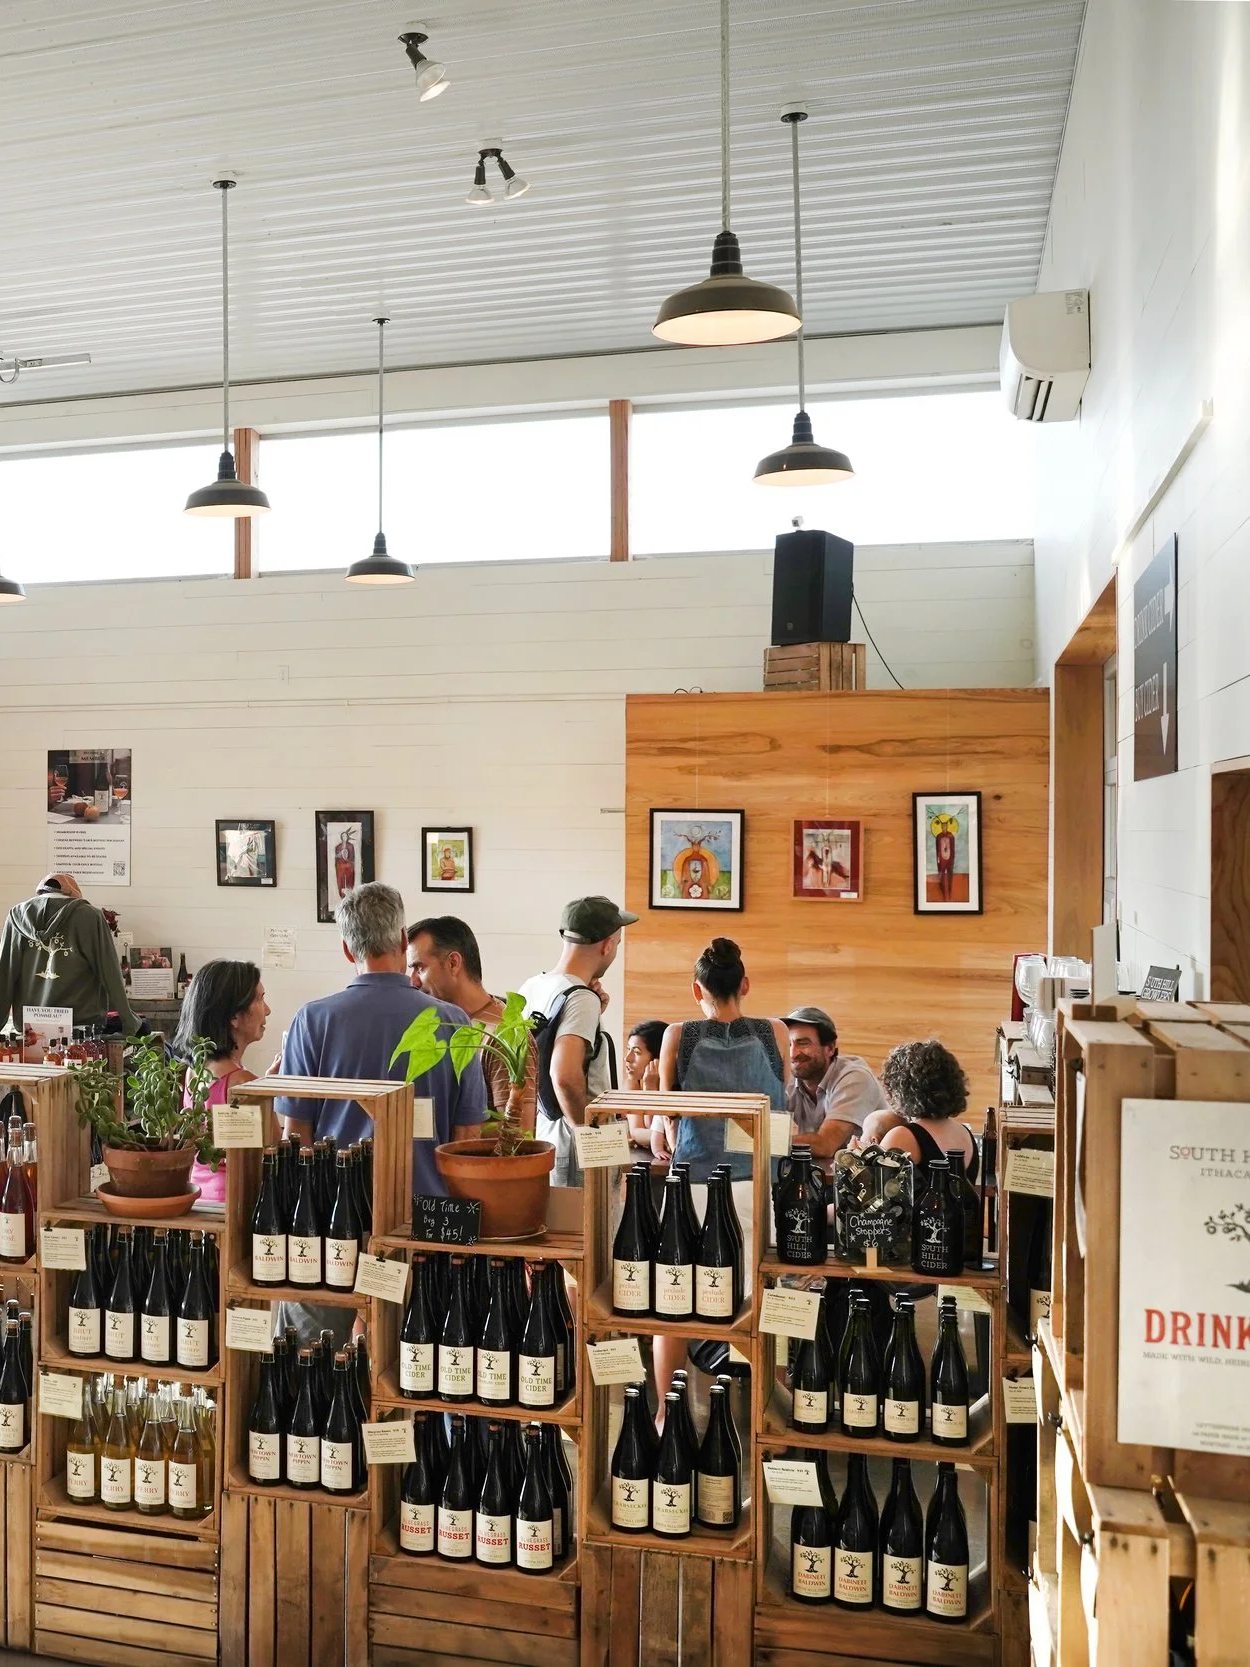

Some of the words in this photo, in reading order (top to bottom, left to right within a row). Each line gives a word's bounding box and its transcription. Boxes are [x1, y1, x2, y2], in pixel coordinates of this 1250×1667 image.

[422, 1199, 436, 1212] Old
[442, 1216, 449, 1226] 3
[850, 1214, 893, 1230] Champagne
[440, 1225, 463, 1242] $45!
[787, 1234, 813, 1243] SOUTH
[787, 1243, 808, 1251] HILL
[921, 1244, 949, 1253] SOUTH
[787, 1251, 812, 1259] CIDER
[921, 1252, 943, 1260] HILL
[921, 1261, 948, 1270] CIDER
[444, 1374, 466, 1382] CIDER
[520, 1376, 533, 1384] OLD
[401, 1523, 432, 1534] RUSSET
[439, 1529, 470, 1540] RUSSET
[477, 1535, 509, 1546] RUSSET
[518, 1541, 551, 1552] RUSSET
[839, 1584, 867, 1592] BALDWIN
[889, 1590, 918, 1598] BALDWIN
[933, 1597, 962, 1605] BALDWIN
